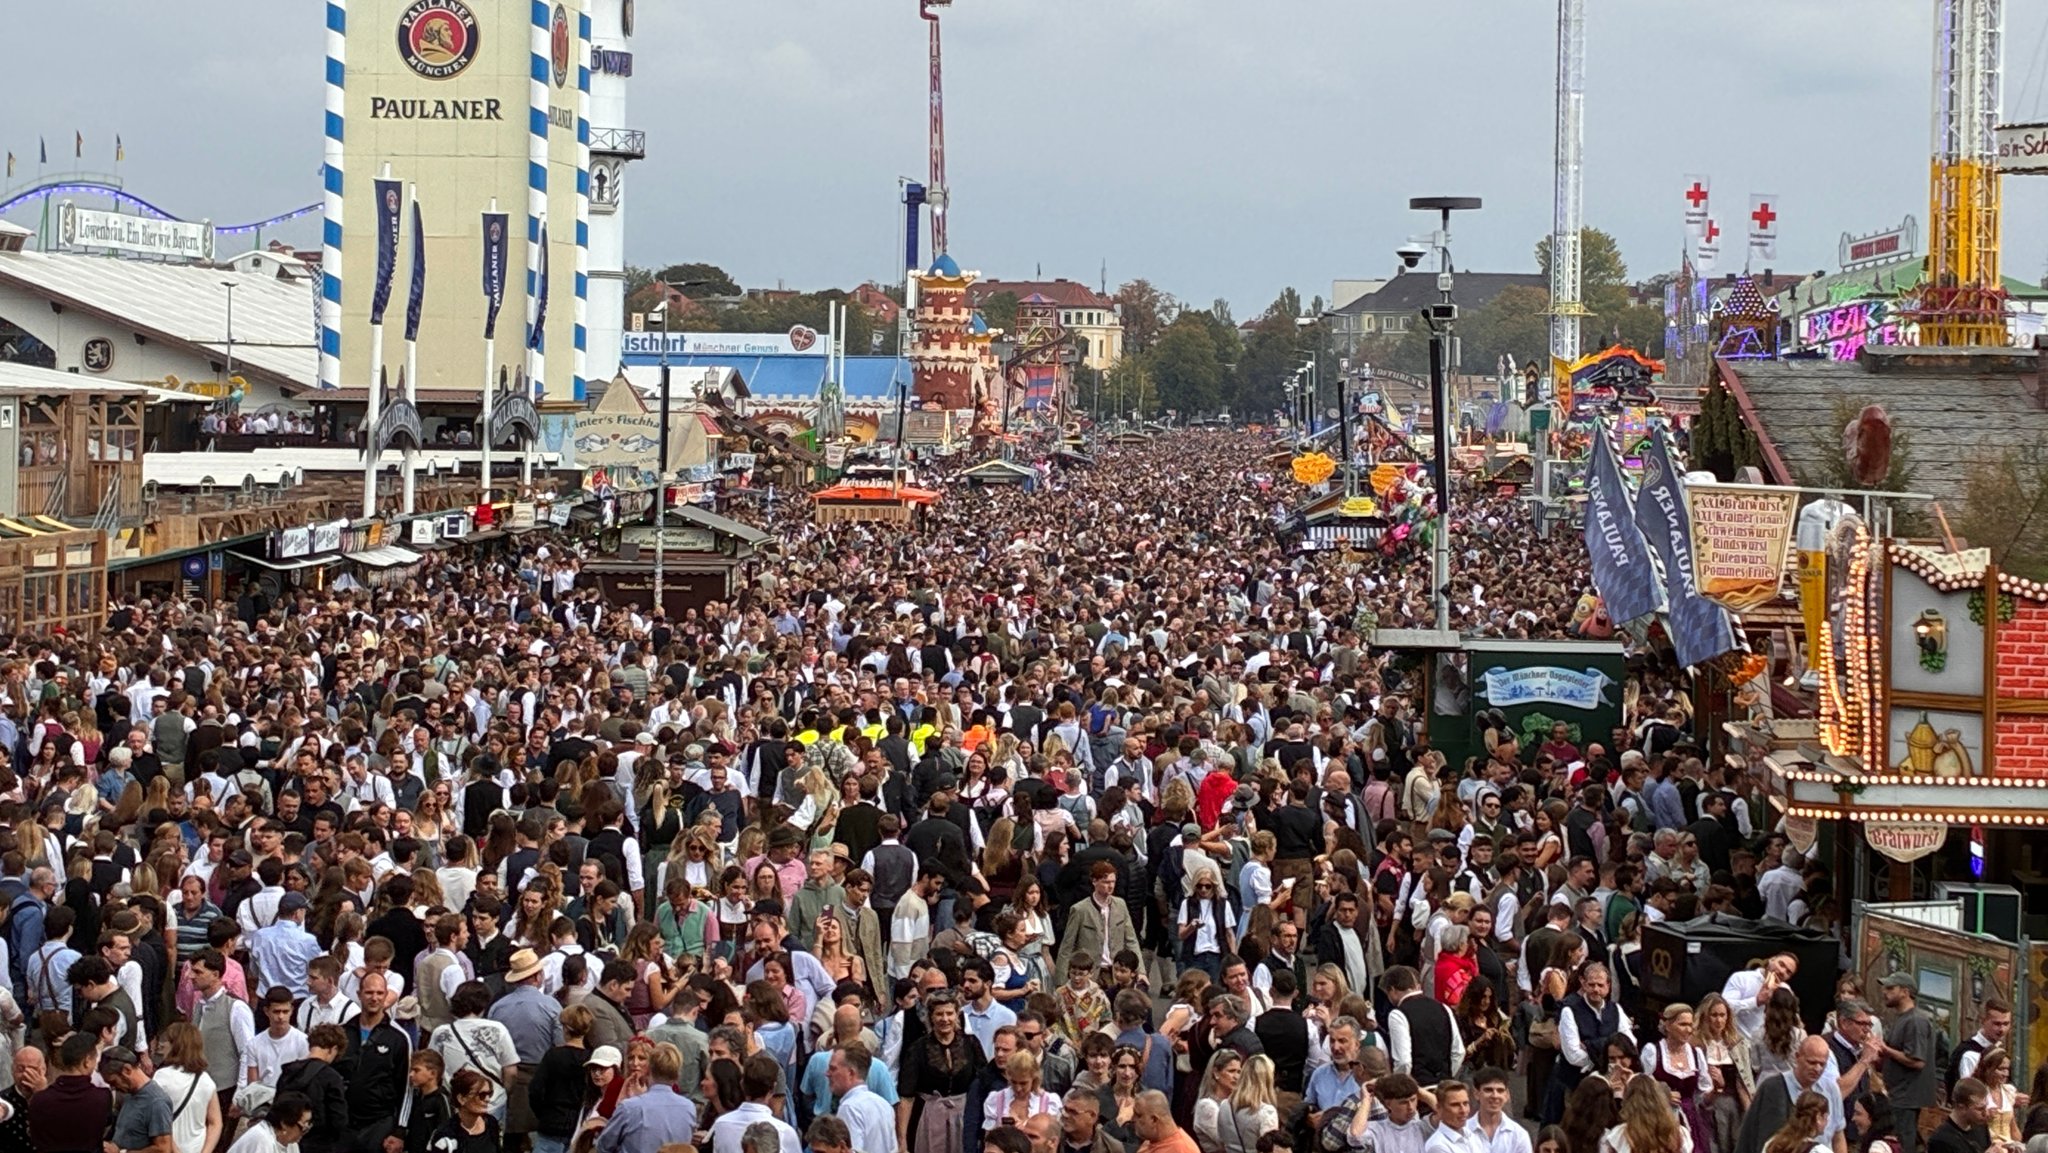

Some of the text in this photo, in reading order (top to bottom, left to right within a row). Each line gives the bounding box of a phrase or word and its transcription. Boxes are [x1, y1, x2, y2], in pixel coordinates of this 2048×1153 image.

[402, 0, 474, 28] PAULANER
[407, 55, 468, 76] MÜNCHEN
[370, 97, 504, 120] PAULANER
[127, 222, 140, 244] Ein
[142, 224, 157, 246] Bier
[158, 227, 171, 247] wie
[173, 228, 200, 250] Bayern.
[1809, 303, 1880, 345] BREAK
[621, 333, 780, 353] ischart Münchner Genuss
[574, 415, 614, 429] inter's
[1724, 499, 1780, 512] Bratwurst
[1695, 510, 1712, 522] XXL
[1715, 511, 1754, 523] Krainer
[1712, 538, 1768, 551] Rindswurst
[1711, 552, 1768, 565] Putenwurst
[1703, 564, 1775, 578] Pommes Frites
[1871, 829, 1940, 849] Bratwurst
